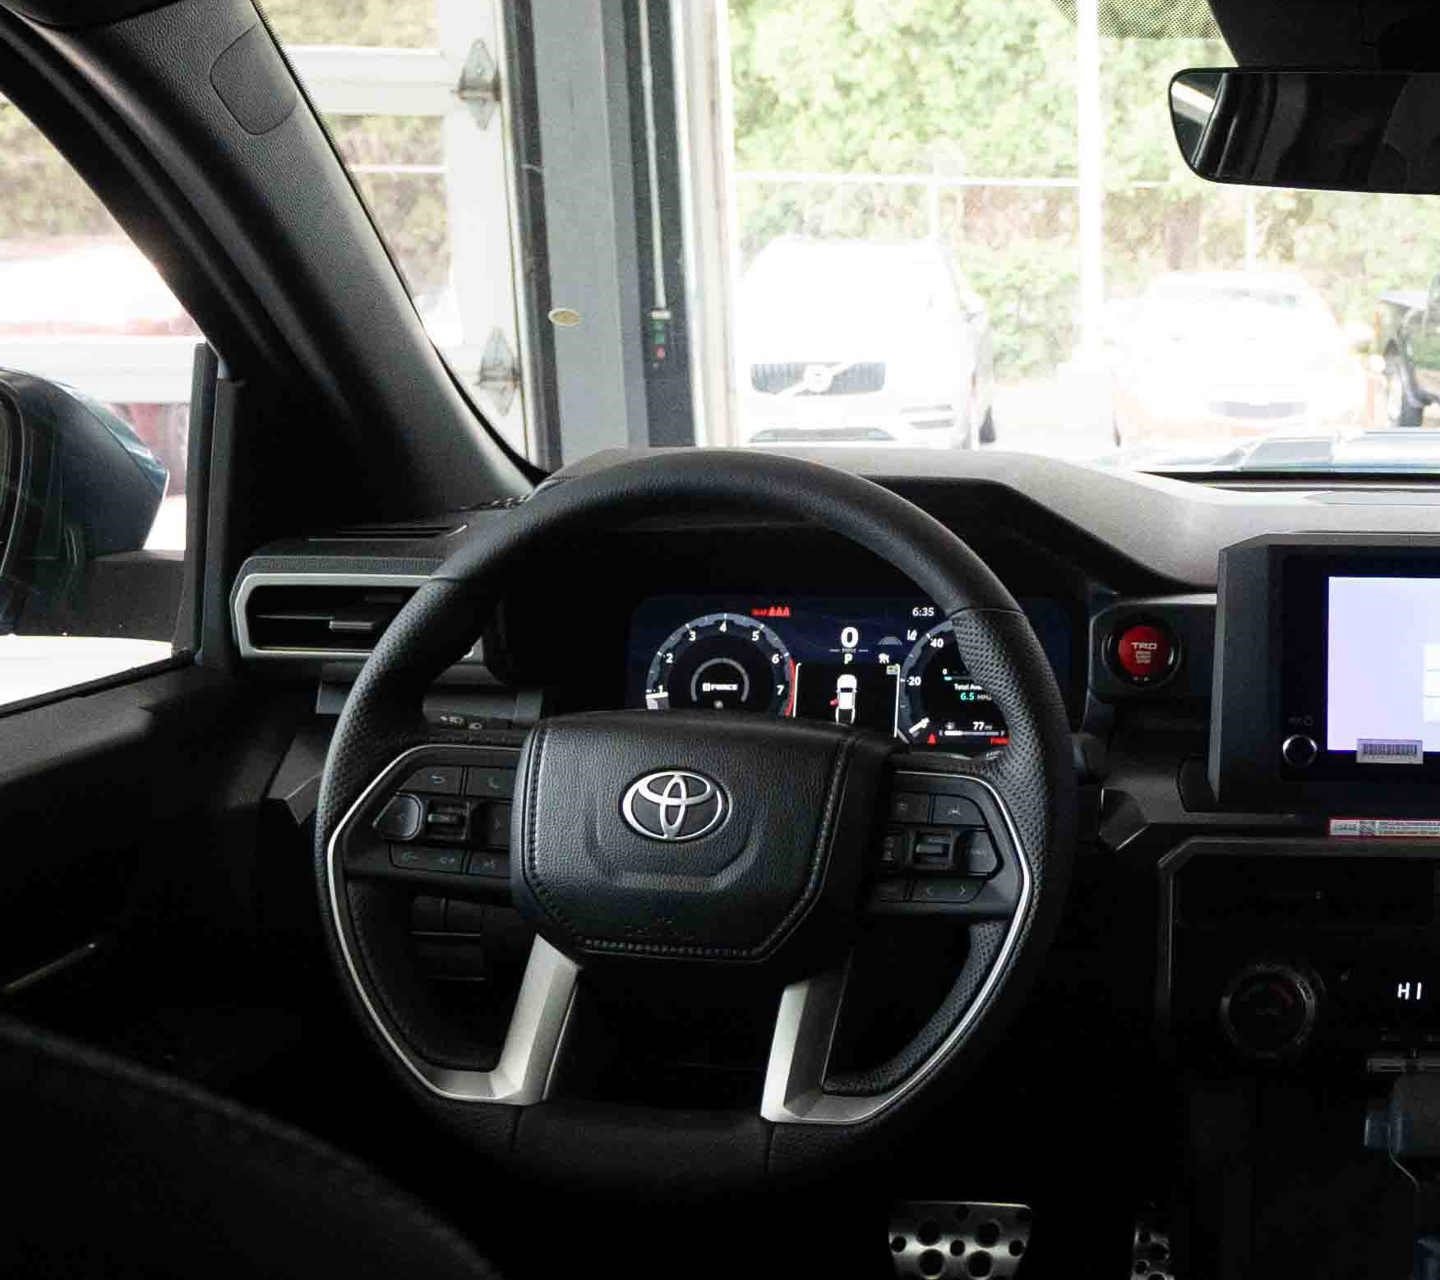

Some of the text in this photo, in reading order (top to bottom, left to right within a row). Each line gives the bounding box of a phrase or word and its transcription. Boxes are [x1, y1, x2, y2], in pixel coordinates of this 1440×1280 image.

[912, 607, 934, 617] 6:35
[719, 622, 727, 632] 4
[688, 630, 697, 641] 3
[751, 630, 760, 641] 5
[841, 626, 859, 648] 0
[930, 638, 944, 648] 40
[1130, 641, 1158, 650] TRD
[666, 653, 673, 664] 2
[771, 653, 780, 664] 6
[844, 653, 853, 665] P
[908, 676, 922, 686] 20
[658, 684, 664, 693] 1
[776, 684, 785, 696] 7
[972, 721, 985, 730] 77
[1397, 981, 1422, 1000] HI
